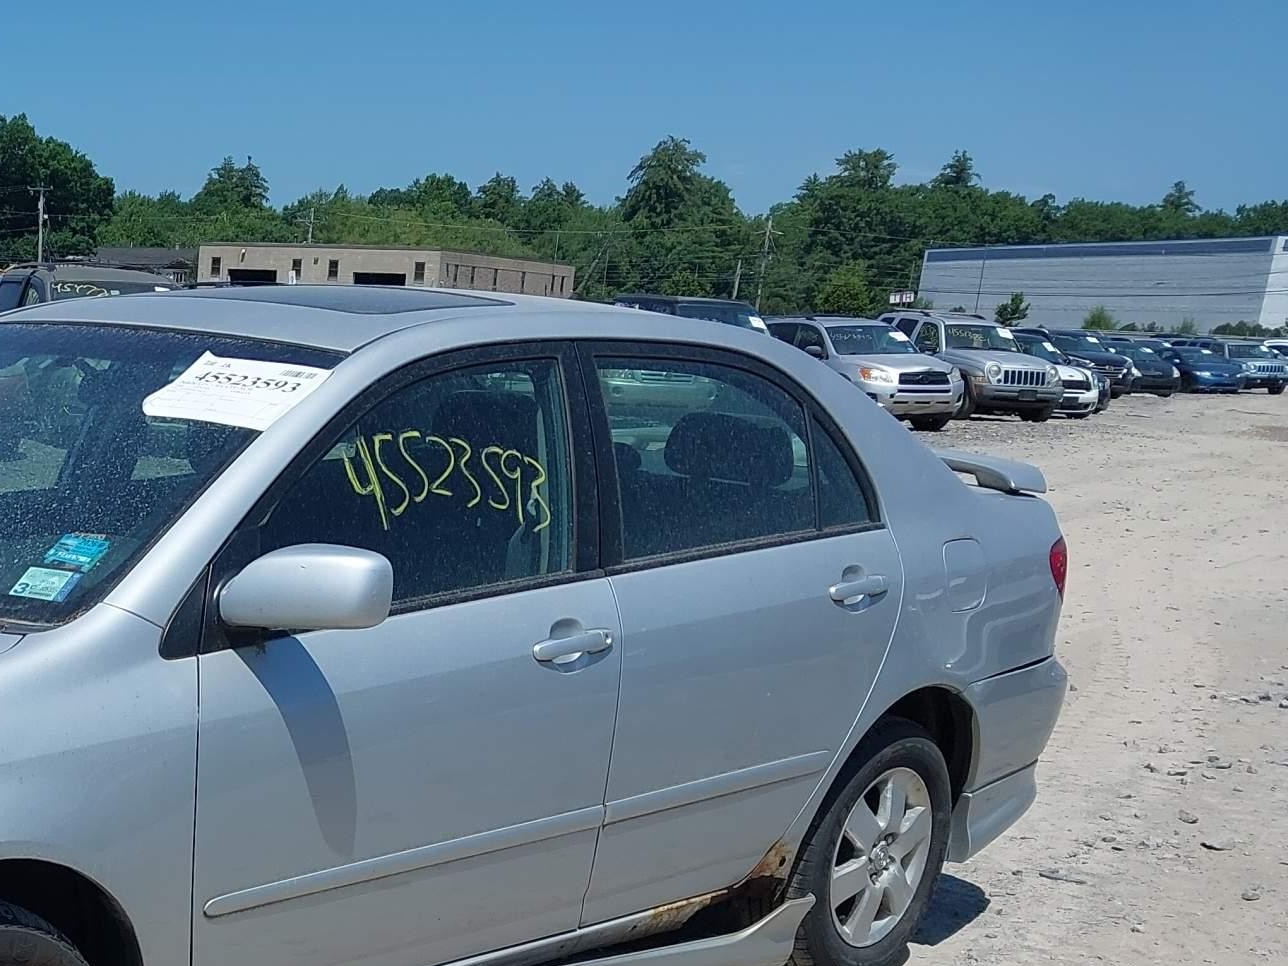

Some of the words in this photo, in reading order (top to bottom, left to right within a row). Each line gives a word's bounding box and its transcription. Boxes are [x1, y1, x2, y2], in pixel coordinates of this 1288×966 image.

[195, 370, 302, 393] 45523593
[343, 430, 551, 533] 45523593
[12, 582, 30, 594] 3
